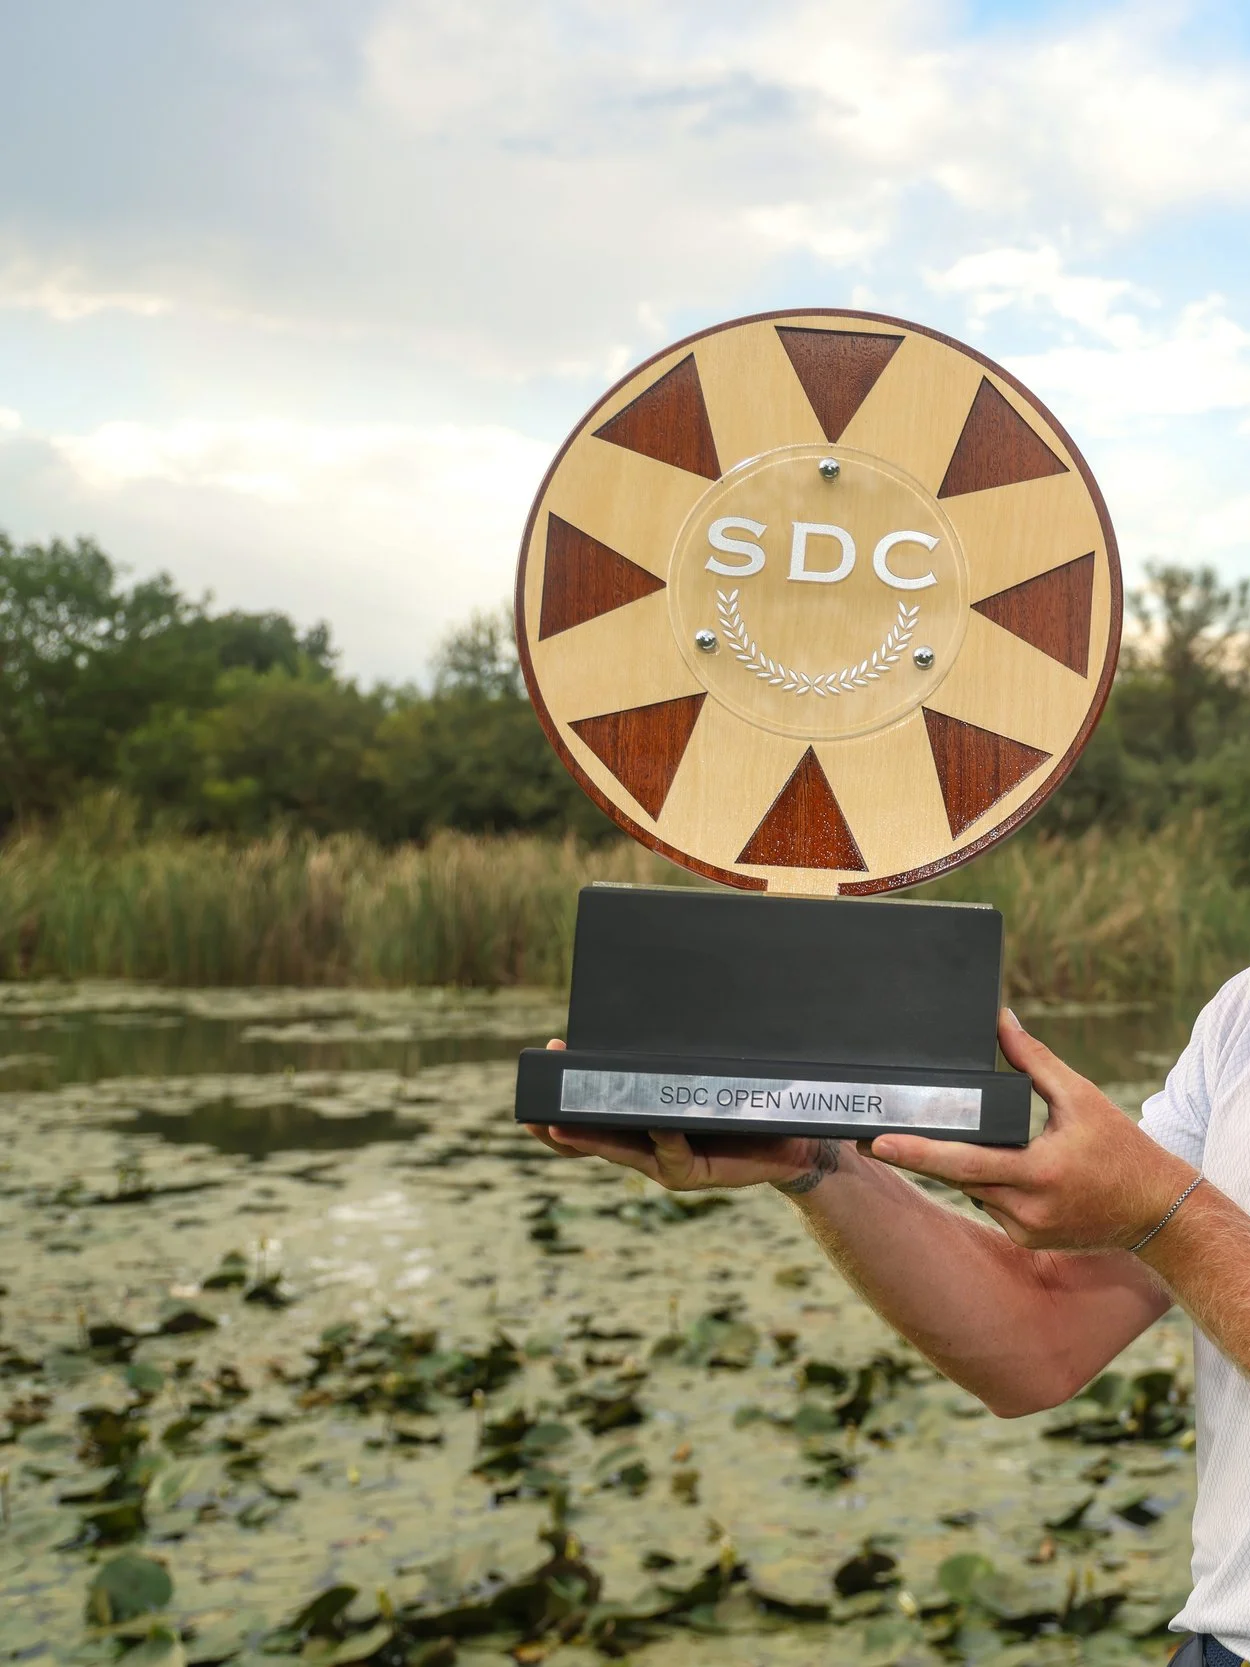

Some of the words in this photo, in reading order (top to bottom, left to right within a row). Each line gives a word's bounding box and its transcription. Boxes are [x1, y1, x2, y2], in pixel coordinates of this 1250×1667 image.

[704, 515, 941, 591] SDC
[659, 1086, 709, 1106] SDC
[716, 1088, 782, 1109] OPEN
[789, 1091, 883, 1114] WINNER
